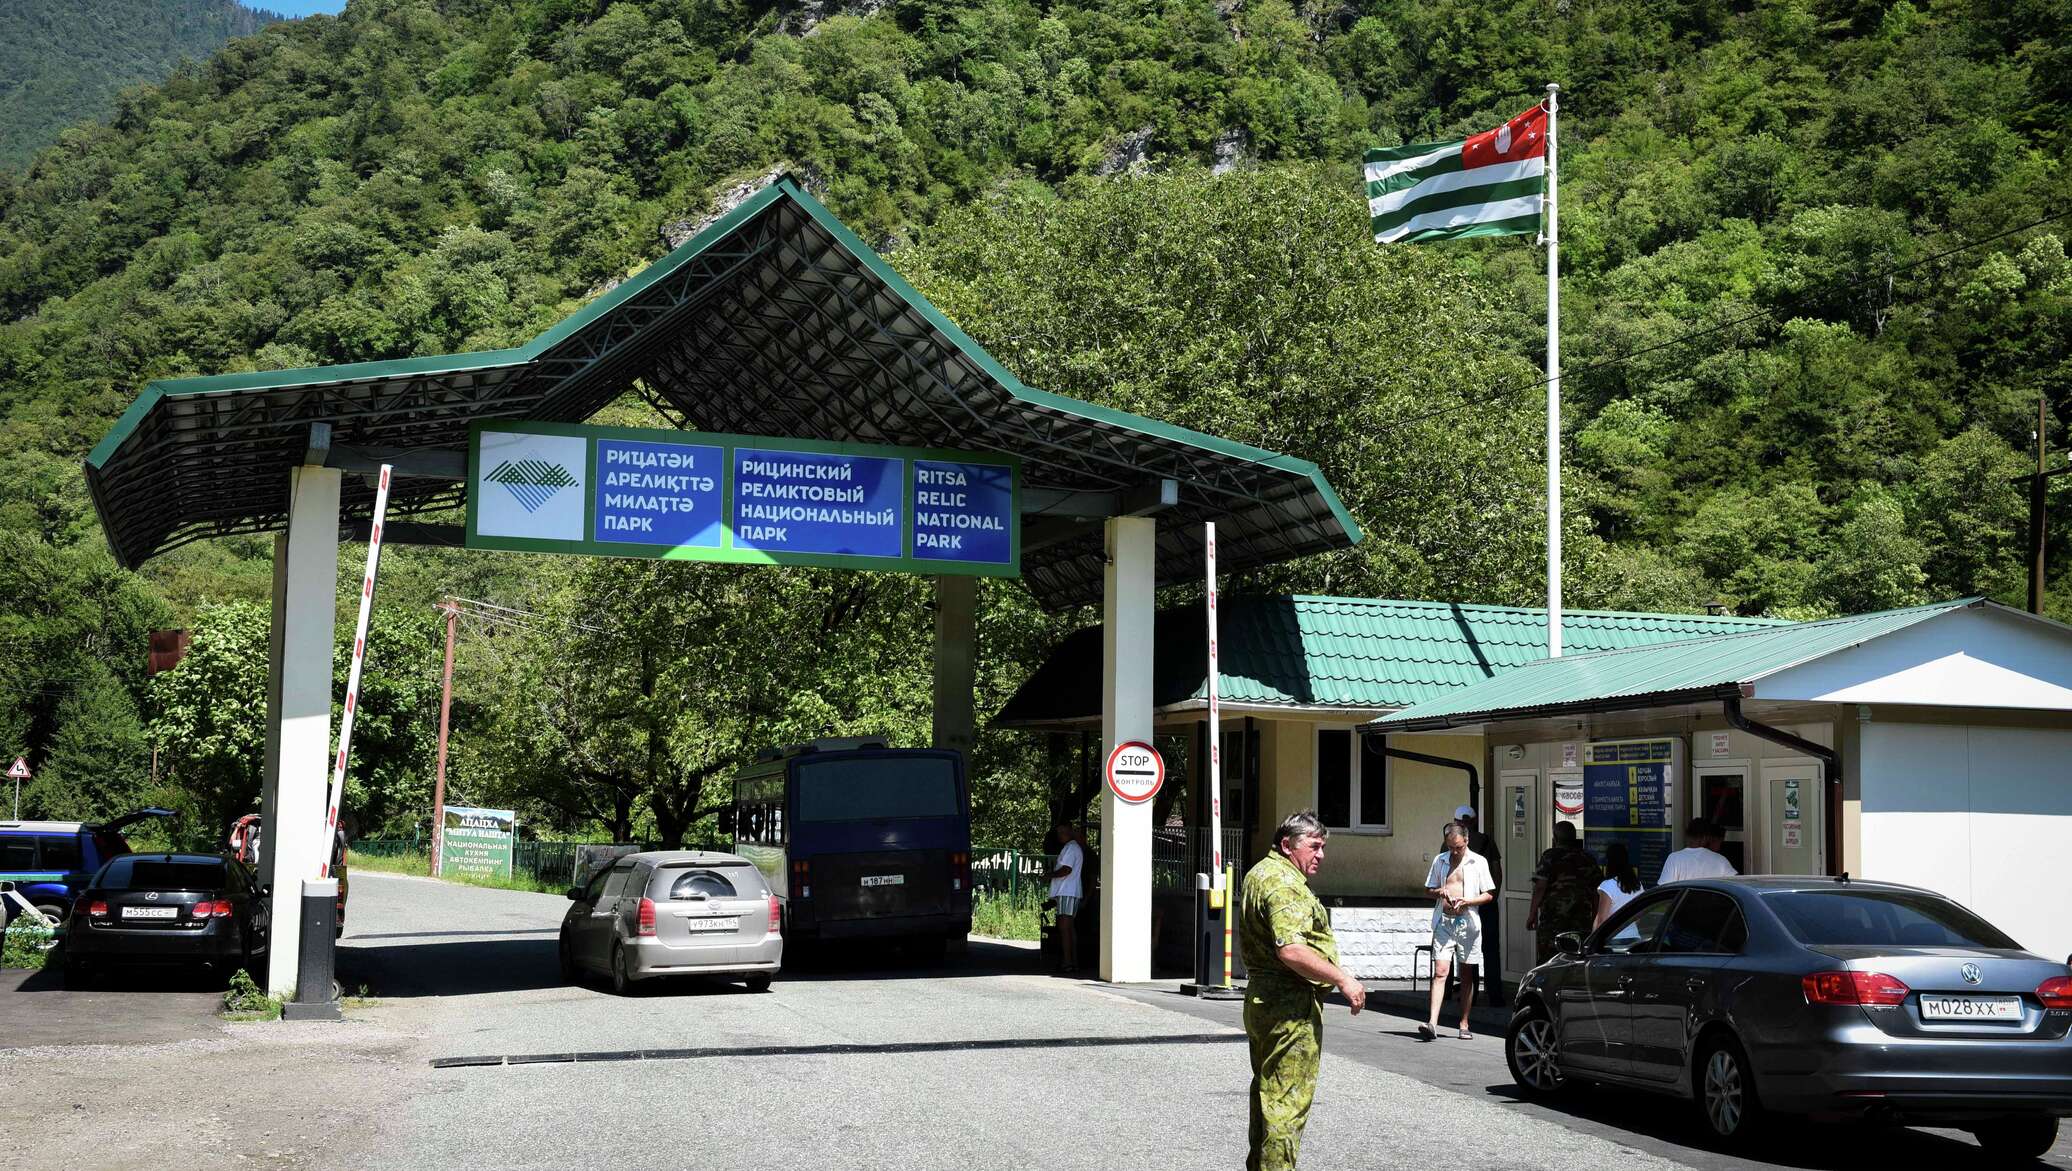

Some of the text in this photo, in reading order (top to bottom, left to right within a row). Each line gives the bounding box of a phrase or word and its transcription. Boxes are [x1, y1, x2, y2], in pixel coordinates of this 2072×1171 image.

[742, 460, 852, 481] РИЦИНСКИЙ
[918, 470, 967, 486] RITSA
[741, 482, 864, 503] РЕЛИКТОВЫЙ
[918, 491, 967, 507] RELIC
[741, 503, 895, 526] НАЦИОНАЛЬНЫЙ
[917, 511, 1004, 530] NATIONAL
[604, 515, 653, 532] ПАРК
[740, 525, 787, 542] ПАРК
[917, 533, 962, 549] PARK
[1121, 755, 1149, 766] STOP
[1116, 778, 1155, 786] КОНТРОЛЬ
[447, 840, 508, 850] НАЦИОНАЛЬНАЯ
[464, 849, 489, 857] КУХНЯ
[449, 857, 503, 865] АВТОКЕМПИНГ
